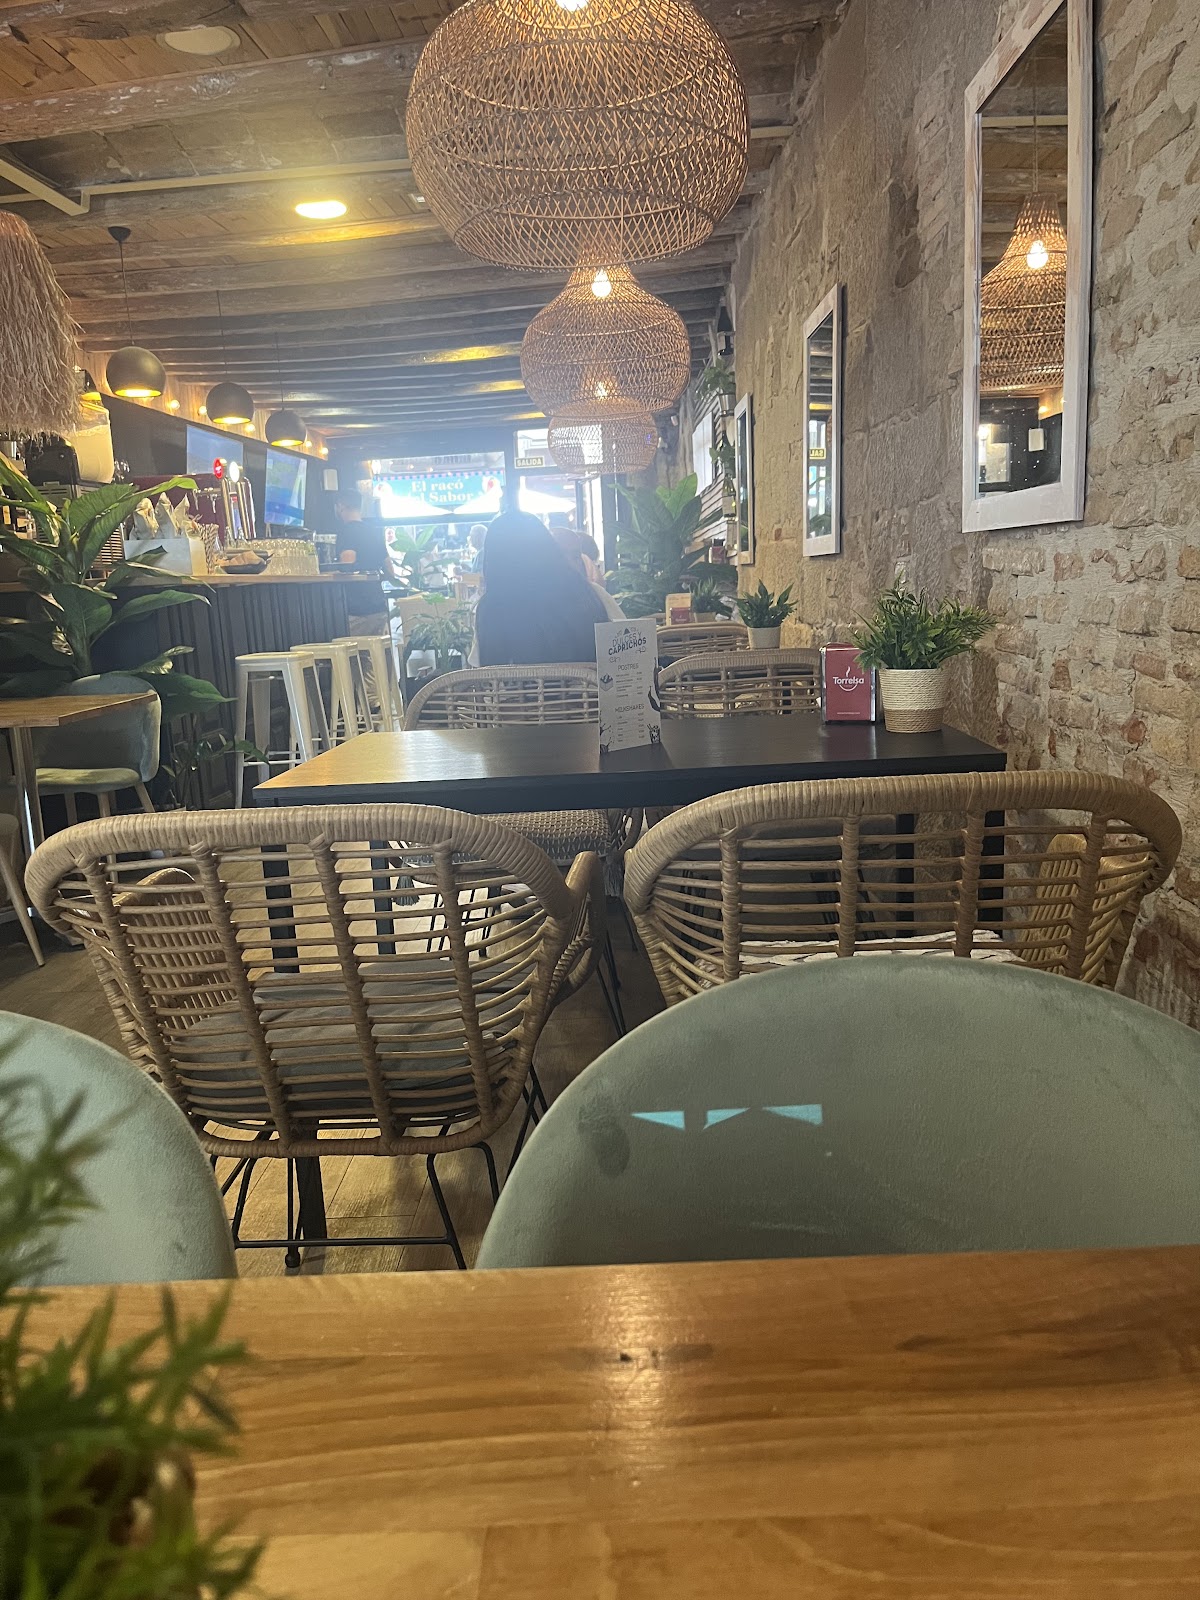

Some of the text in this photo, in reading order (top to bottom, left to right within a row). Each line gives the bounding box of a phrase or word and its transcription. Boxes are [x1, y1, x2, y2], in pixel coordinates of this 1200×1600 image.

[516, 457, 542, 467] SALIDA
[411, 479, 464, 493] El racó
[429, 490, 474, 503] Sabor
[608, 637, 647, 656] CAPRICHOS
[618, 663, 639, 671] POSTRES
